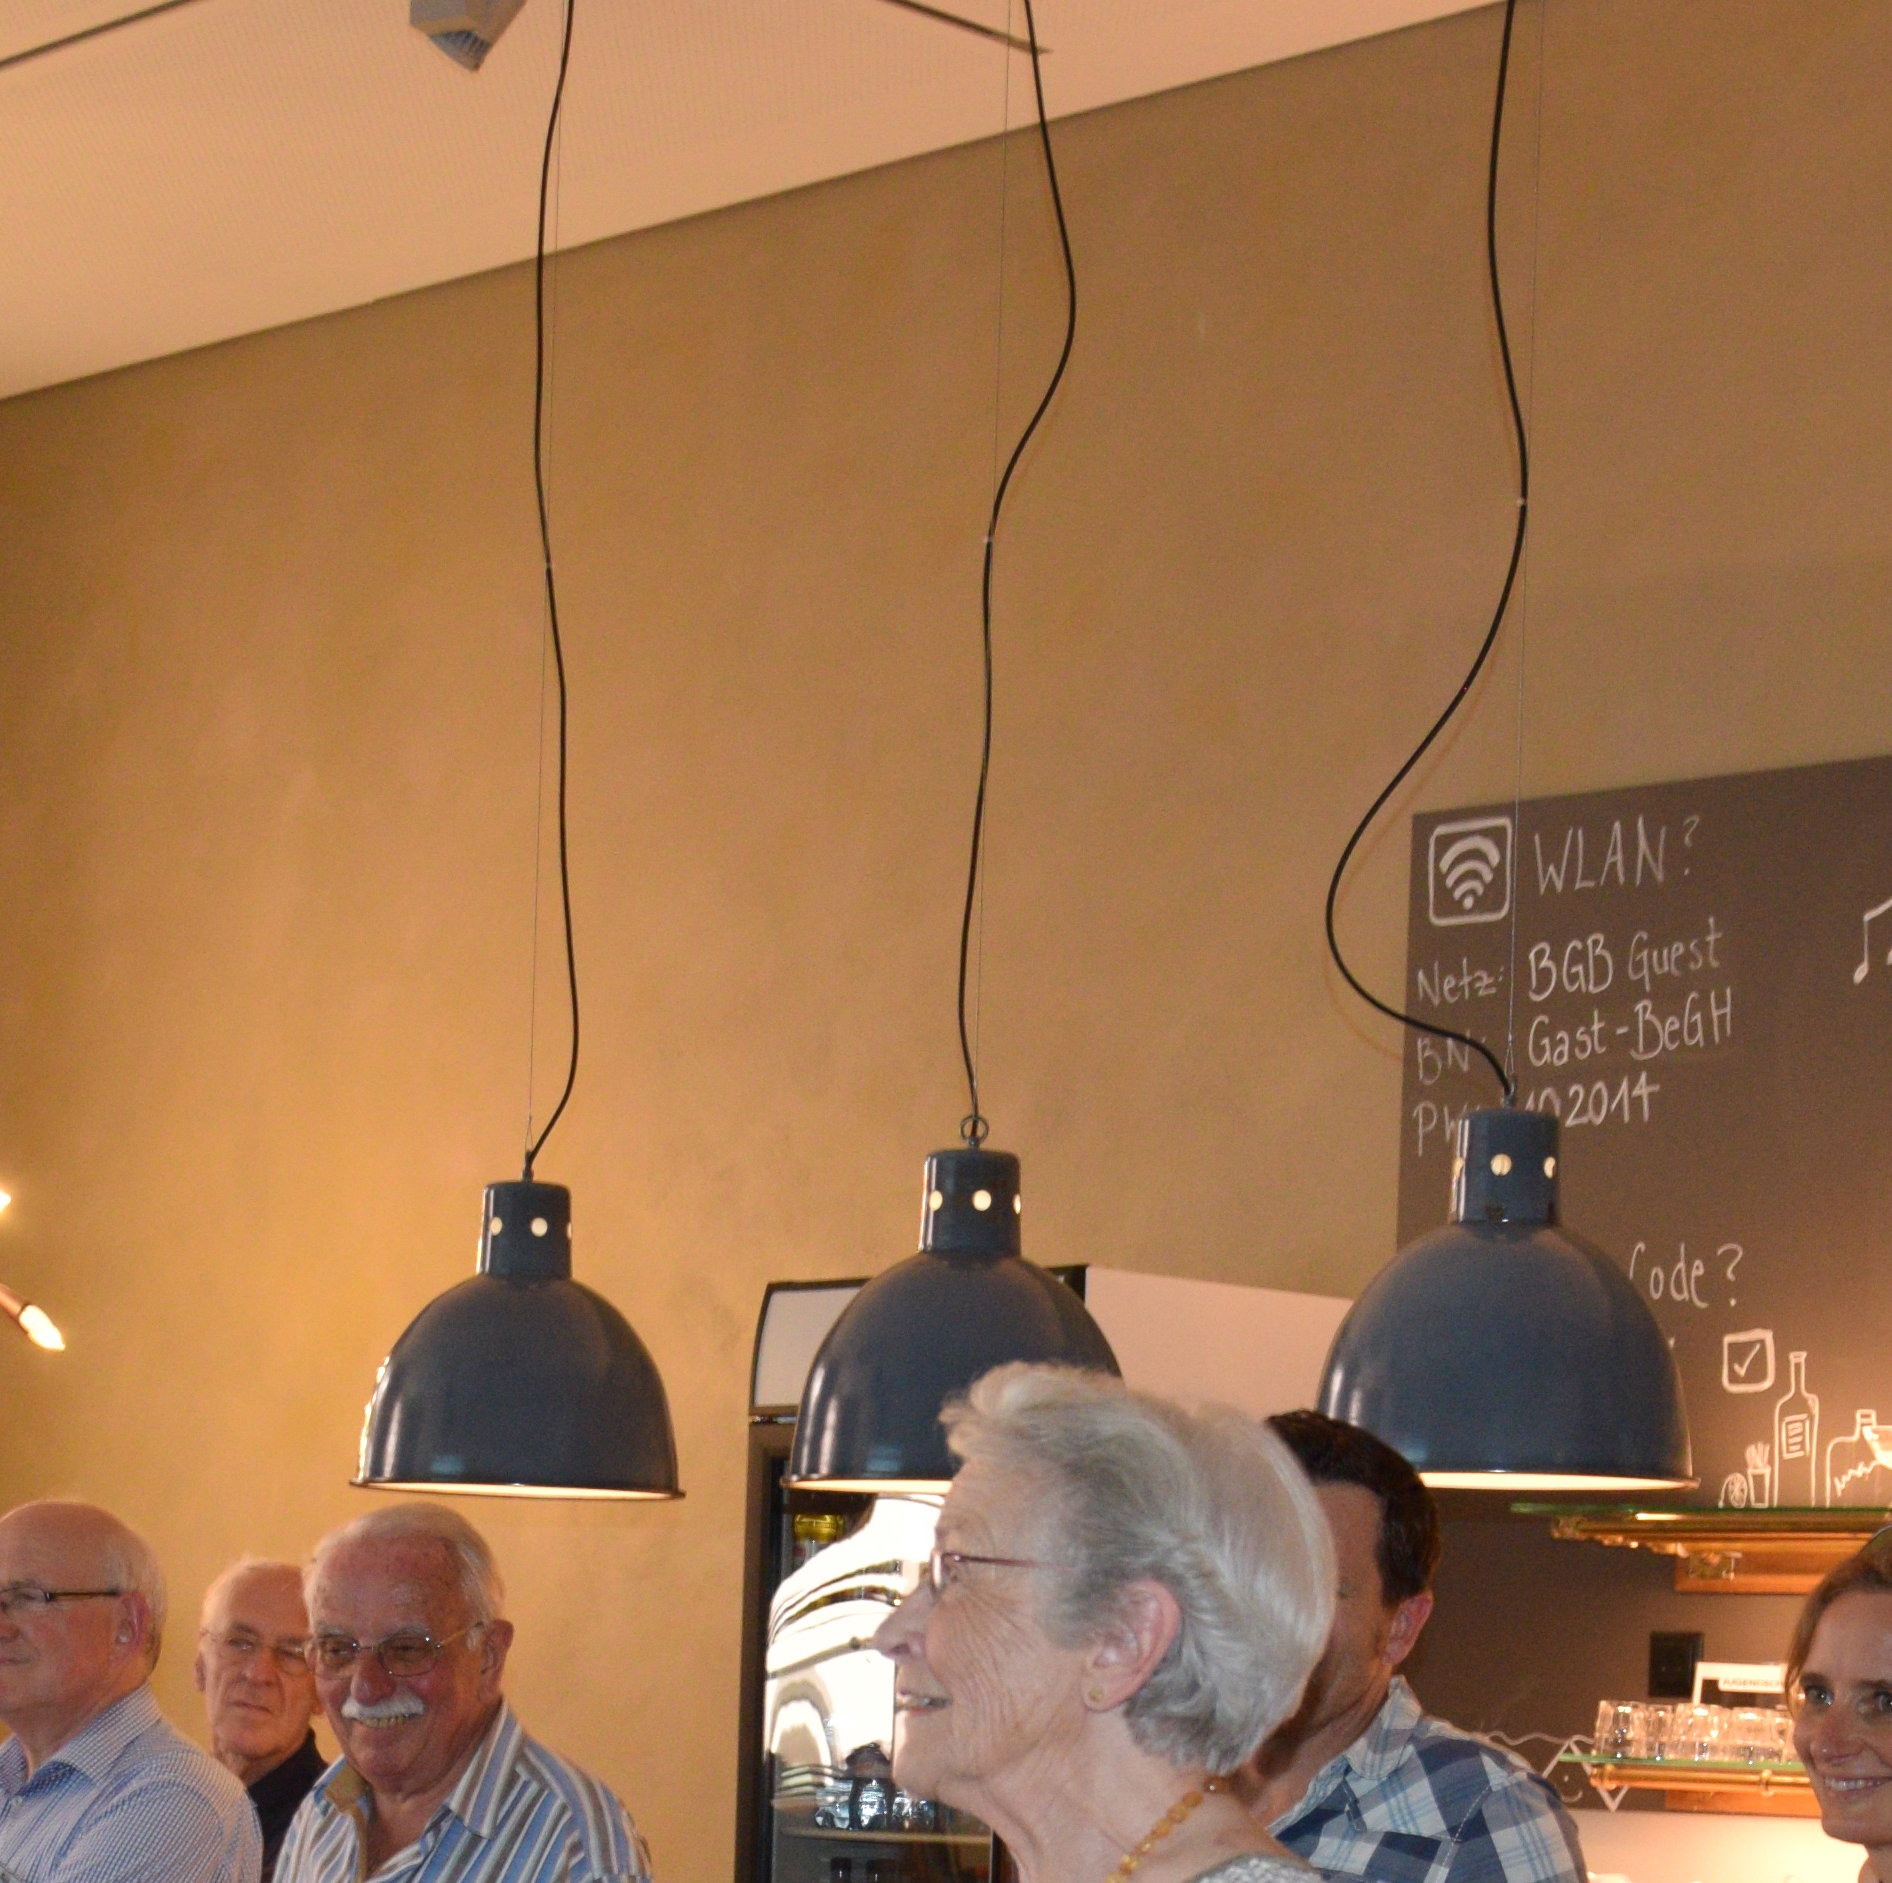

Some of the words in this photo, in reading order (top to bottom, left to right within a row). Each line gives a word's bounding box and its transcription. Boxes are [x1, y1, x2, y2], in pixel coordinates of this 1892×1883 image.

[1534, 813, 1700, 894] WLAN?
[1528, 932, 1613, 1002] BGB
[1627, 915, 1723, 992] Guest
